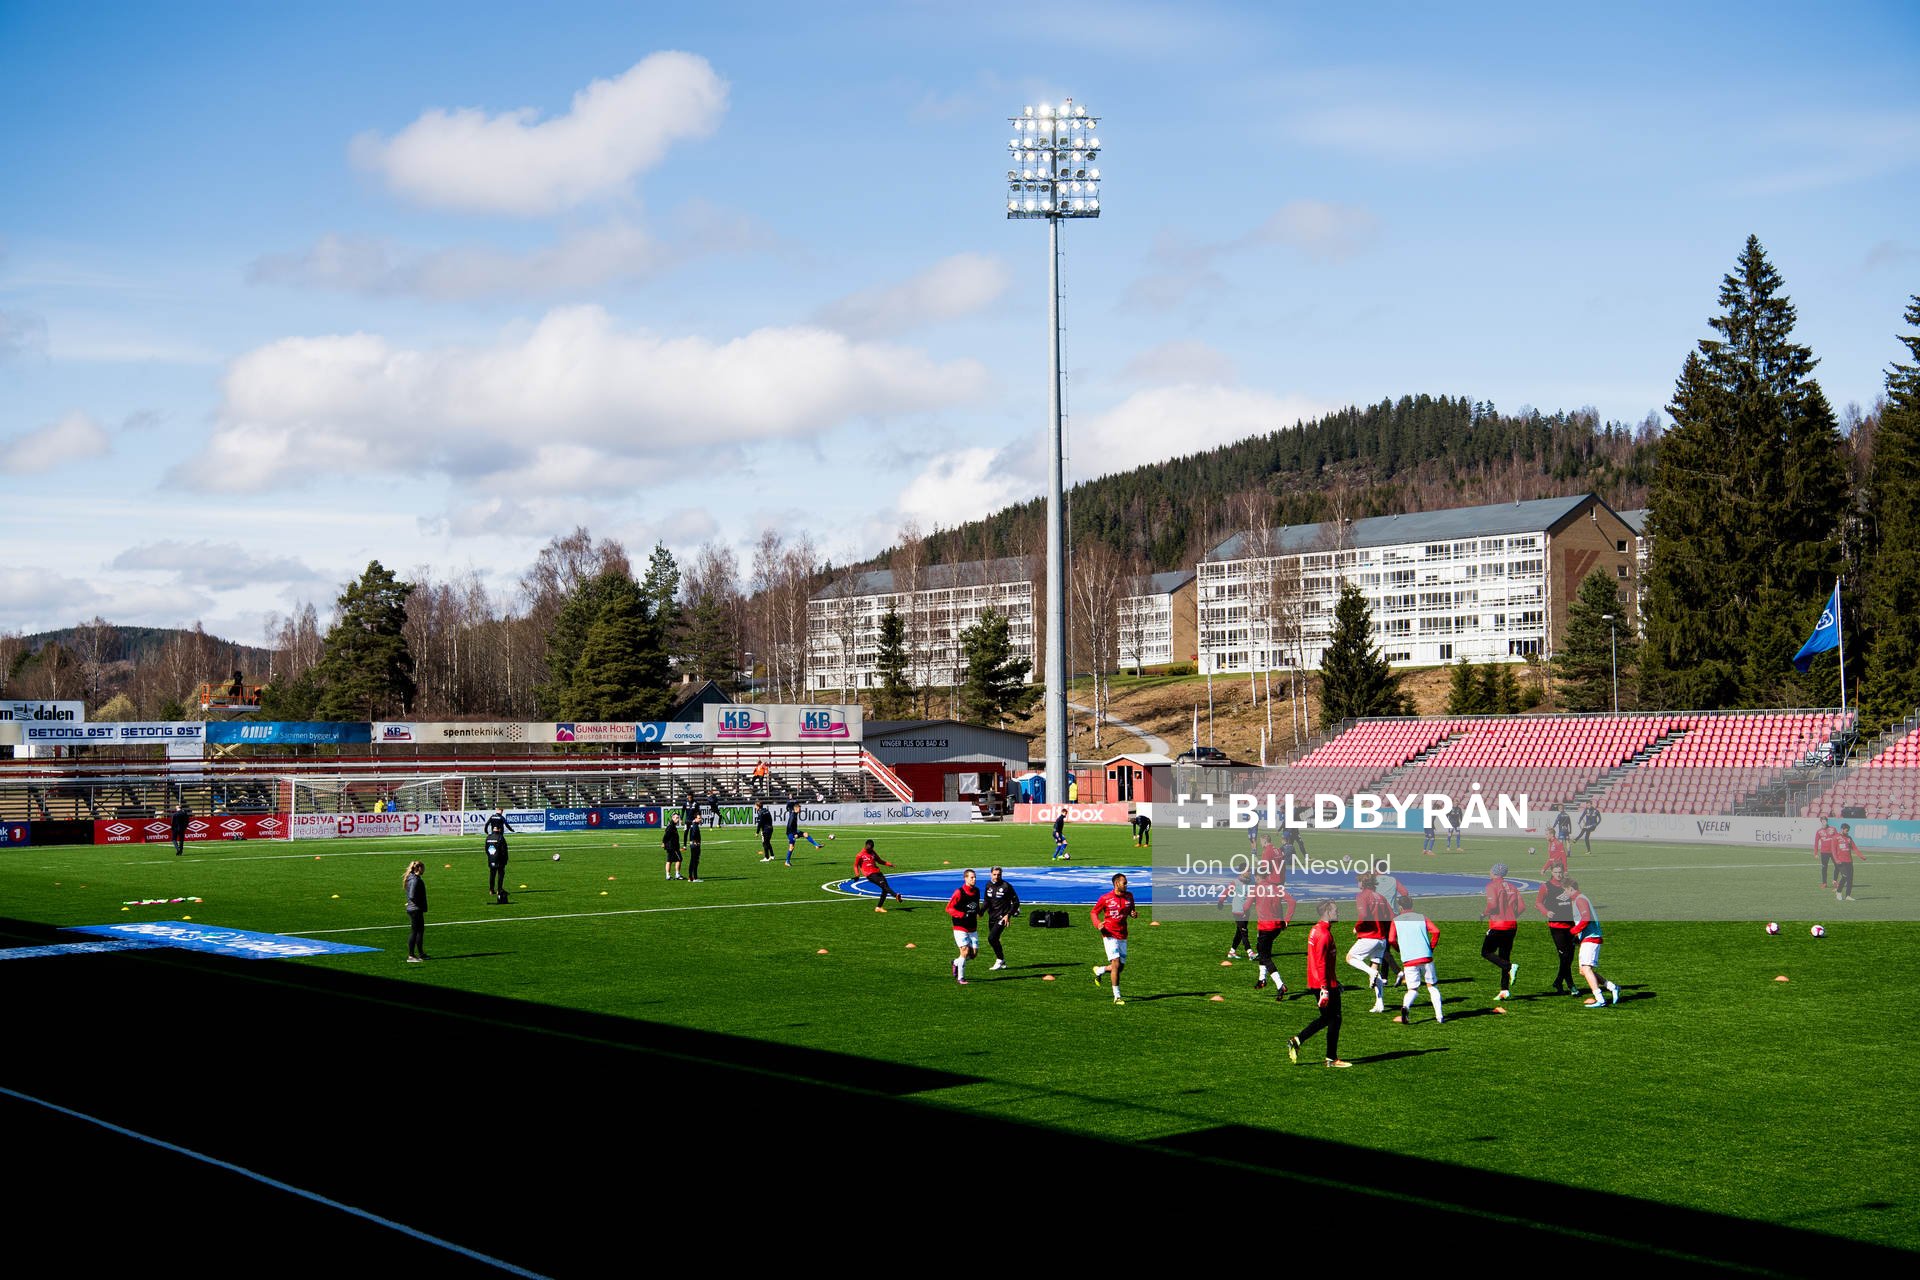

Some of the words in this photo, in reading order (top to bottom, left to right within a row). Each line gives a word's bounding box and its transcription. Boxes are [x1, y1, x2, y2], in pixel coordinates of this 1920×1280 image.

[34, 705, 74, 720] dalen
[724, 711, 751, 729] KB
[805, 711, 832, 729] KB
[28, 728, 83, 737] BETONG
[88, 728, 114, 737] ØST
[120, 727, 173, 736] BETONG
[177, 726, 202, 736] ØST
[386, 727, 401, 736] KB
[443, 727, 504, 738] spennteknikk
[576, 725, 607, 733] GUNNAR
[610, 724, 635, 733] HOLTH
[549, 812, 587, 822] SpareBank
[608, 811, 645, 821] SpareBank
[863, 807, 881, 818] ibas
[357, 814, 401, 824] EIDSIVA
[357, 824, 402, 834] bredbånd
[1696, 820, 1731, 836] VEFLEN
[107, 834, 131, 842] umbro
[184, 831, 207, 839] umbro
[222, 830, 244, 838] umbro
[1755, 829, 1792, 842] Eidsiva
